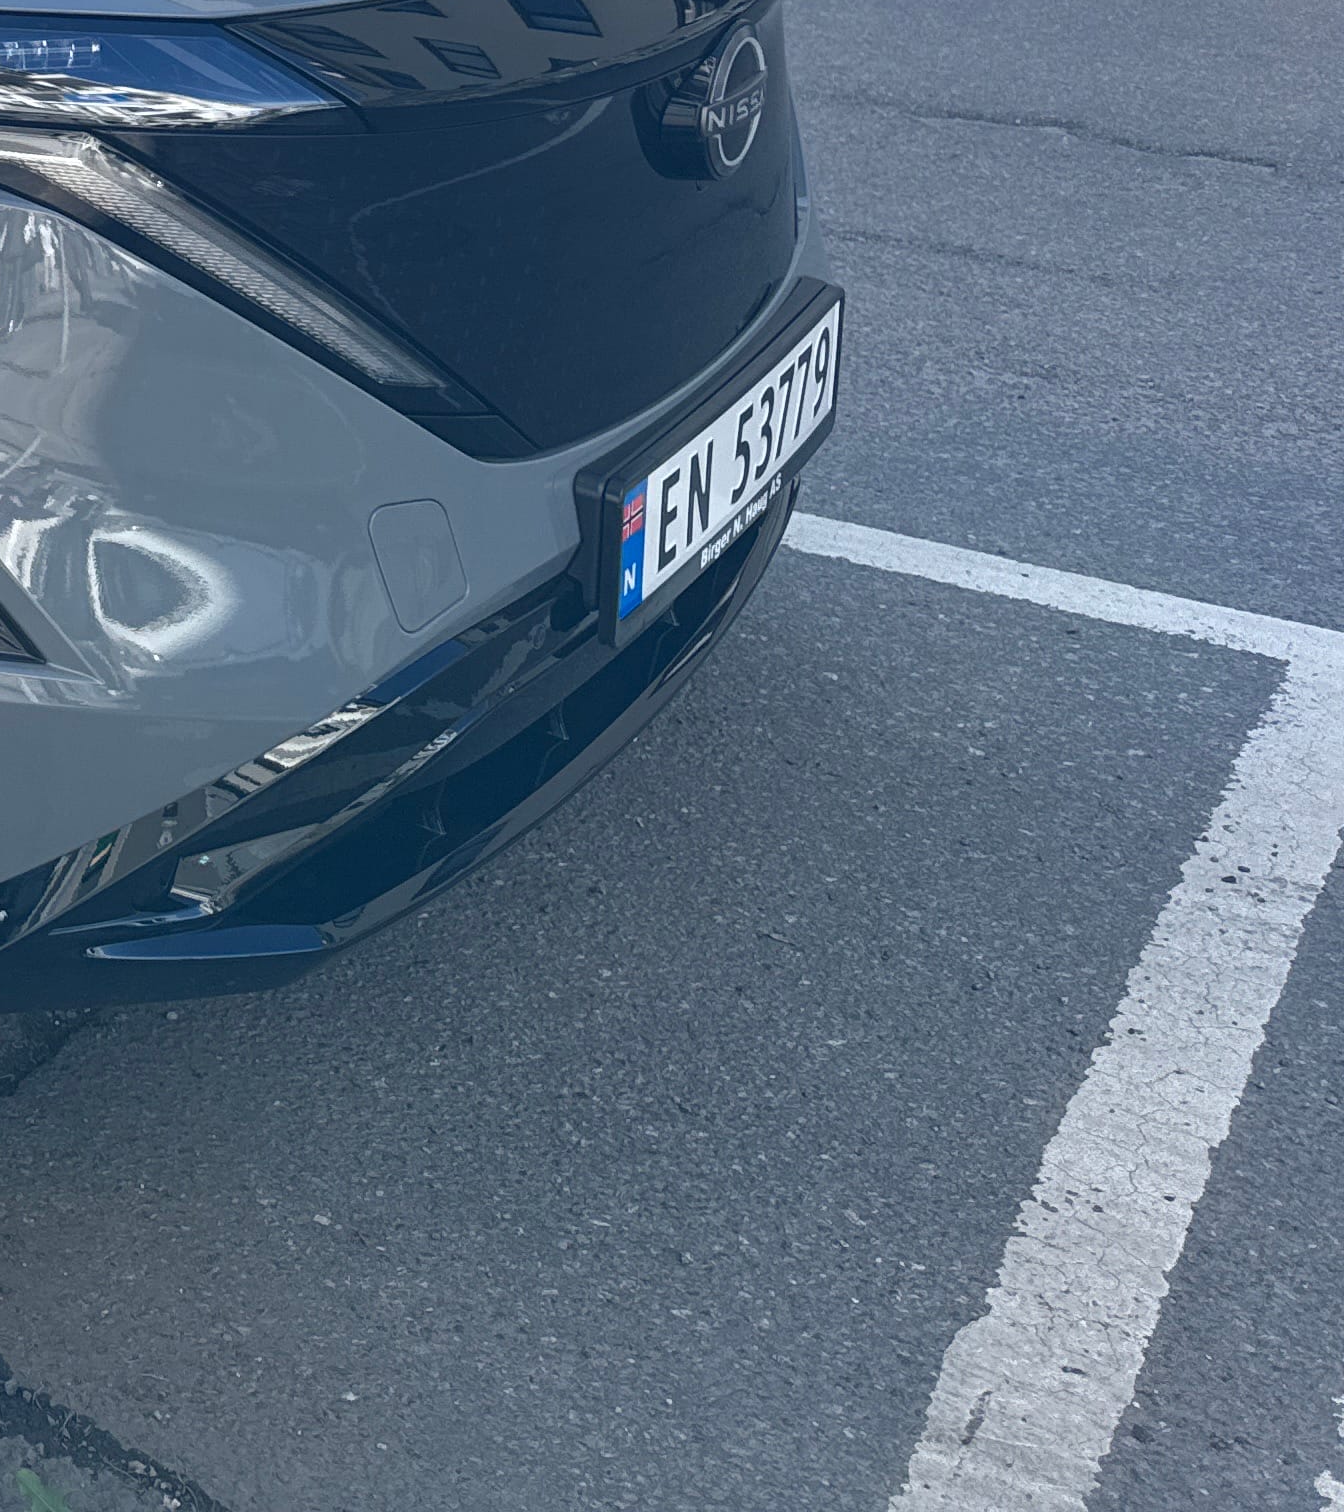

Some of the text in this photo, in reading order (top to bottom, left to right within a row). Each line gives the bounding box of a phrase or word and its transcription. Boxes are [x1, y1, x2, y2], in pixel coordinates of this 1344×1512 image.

[708, 89, 764, 132] NISS
[657, 326, 830, 573] EN 53779
[700, 528, 731, 569] Birger
[745, 490, 768, 525] Haug
[769, 472, 782, 500] AS
[623, 563, 637, 596] N
